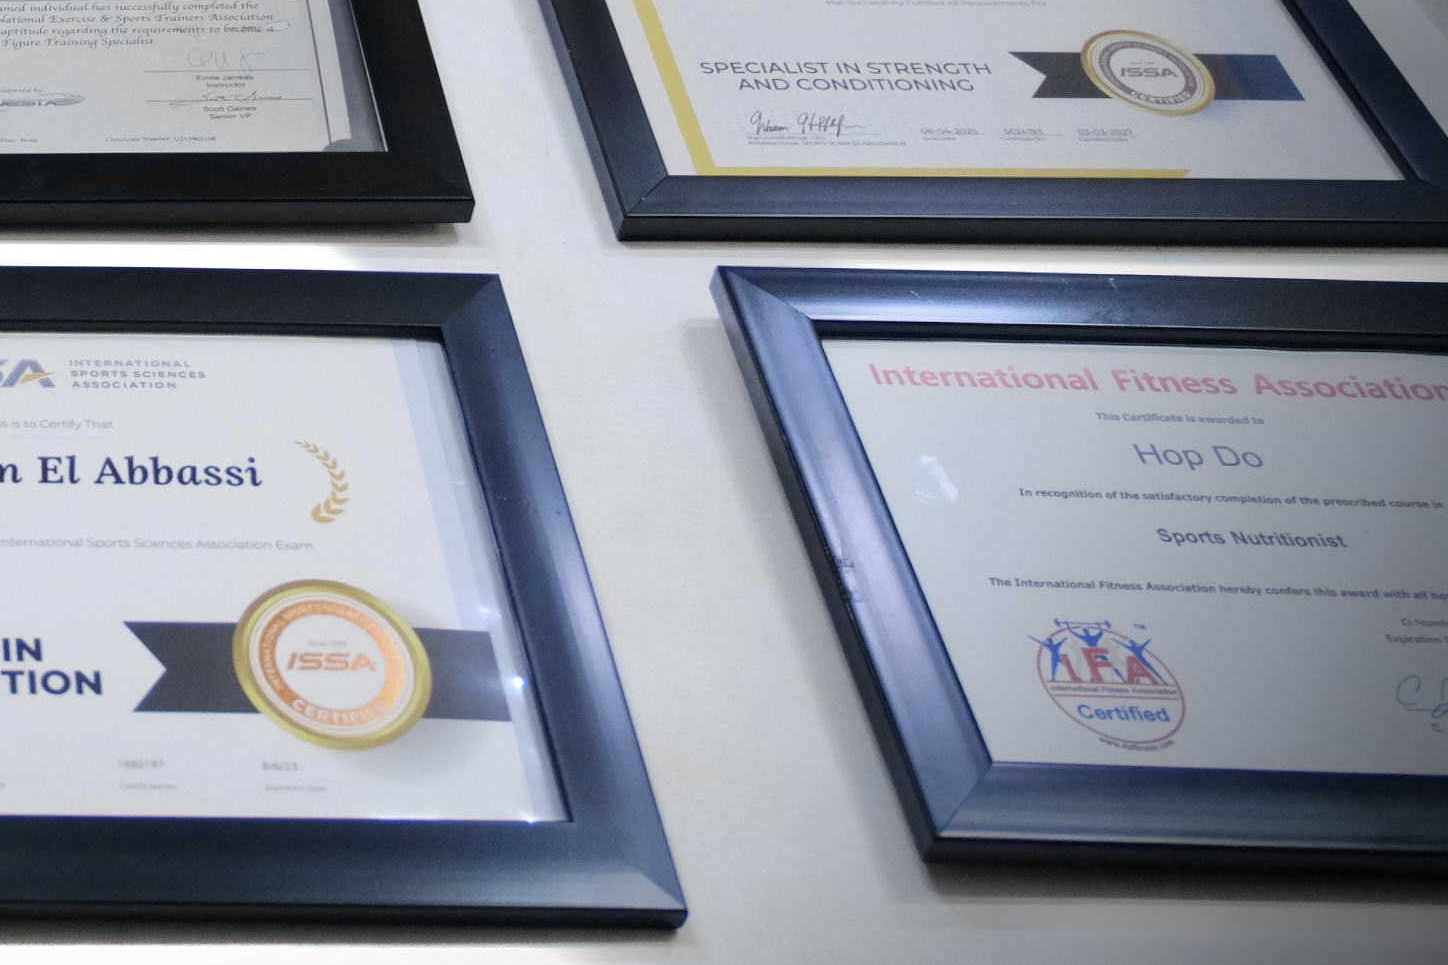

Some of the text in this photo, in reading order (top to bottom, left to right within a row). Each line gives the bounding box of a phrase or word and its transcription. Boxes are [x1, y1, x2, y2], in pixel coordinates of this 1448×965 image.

[30, 2, 89, 12] individual
[92, 2, 110, 11] has
[114, 2, 179, 13] successfully
[182, 2, 238, 13] completed
[241, 1, 258, 10] the
[1, 38, 40, 50] Figure
[45, 37, 98, 49] Training
[700, 61, 992, 76] SPECIALIST IN STRENGTH
[738, 78, 975, 92] AND CONDITIONING
[69, 359, 191, 368] INTERNATIONAL
[70, 369, 206, 379] SPORTS SCIENCES
[868, 363, 1100, 391] International
[1110, 368, 1239, 395] Fitness
[71, 380, 177, 389] ASSOCIATION
[11, 419, 20, 429] is
[23, 420, 37, 429] to
[39, 419, 82, 431] Certify
[85, 419, 114, 430] That
[1094, 411, 1265, 425] This Certificate is awarded to
[1132, 443, 1264, 471] Hop Do
[37, 454, 80, 485] El
[93, 455, 263, 487] Abbassi
[1018, 487, 1444, 509] In recognition of the satisfactory completion of the prescribed course in
[86, 537, 132, 550] Sports
[132, 537, 194, 550] Sciences
[195, 539, 273, 551] Association
[274, 539, 314, 551] Exam
[1156, 528, 1348, 548] Sports Nutritionist
[987, 577, 1428, 600] The International Fitness Association hereby confers this award with all
[2, 637, 43, 662] IN
[286, 651, 377, 672] ISSA
[1077, 704, 1171, 722] Certified
